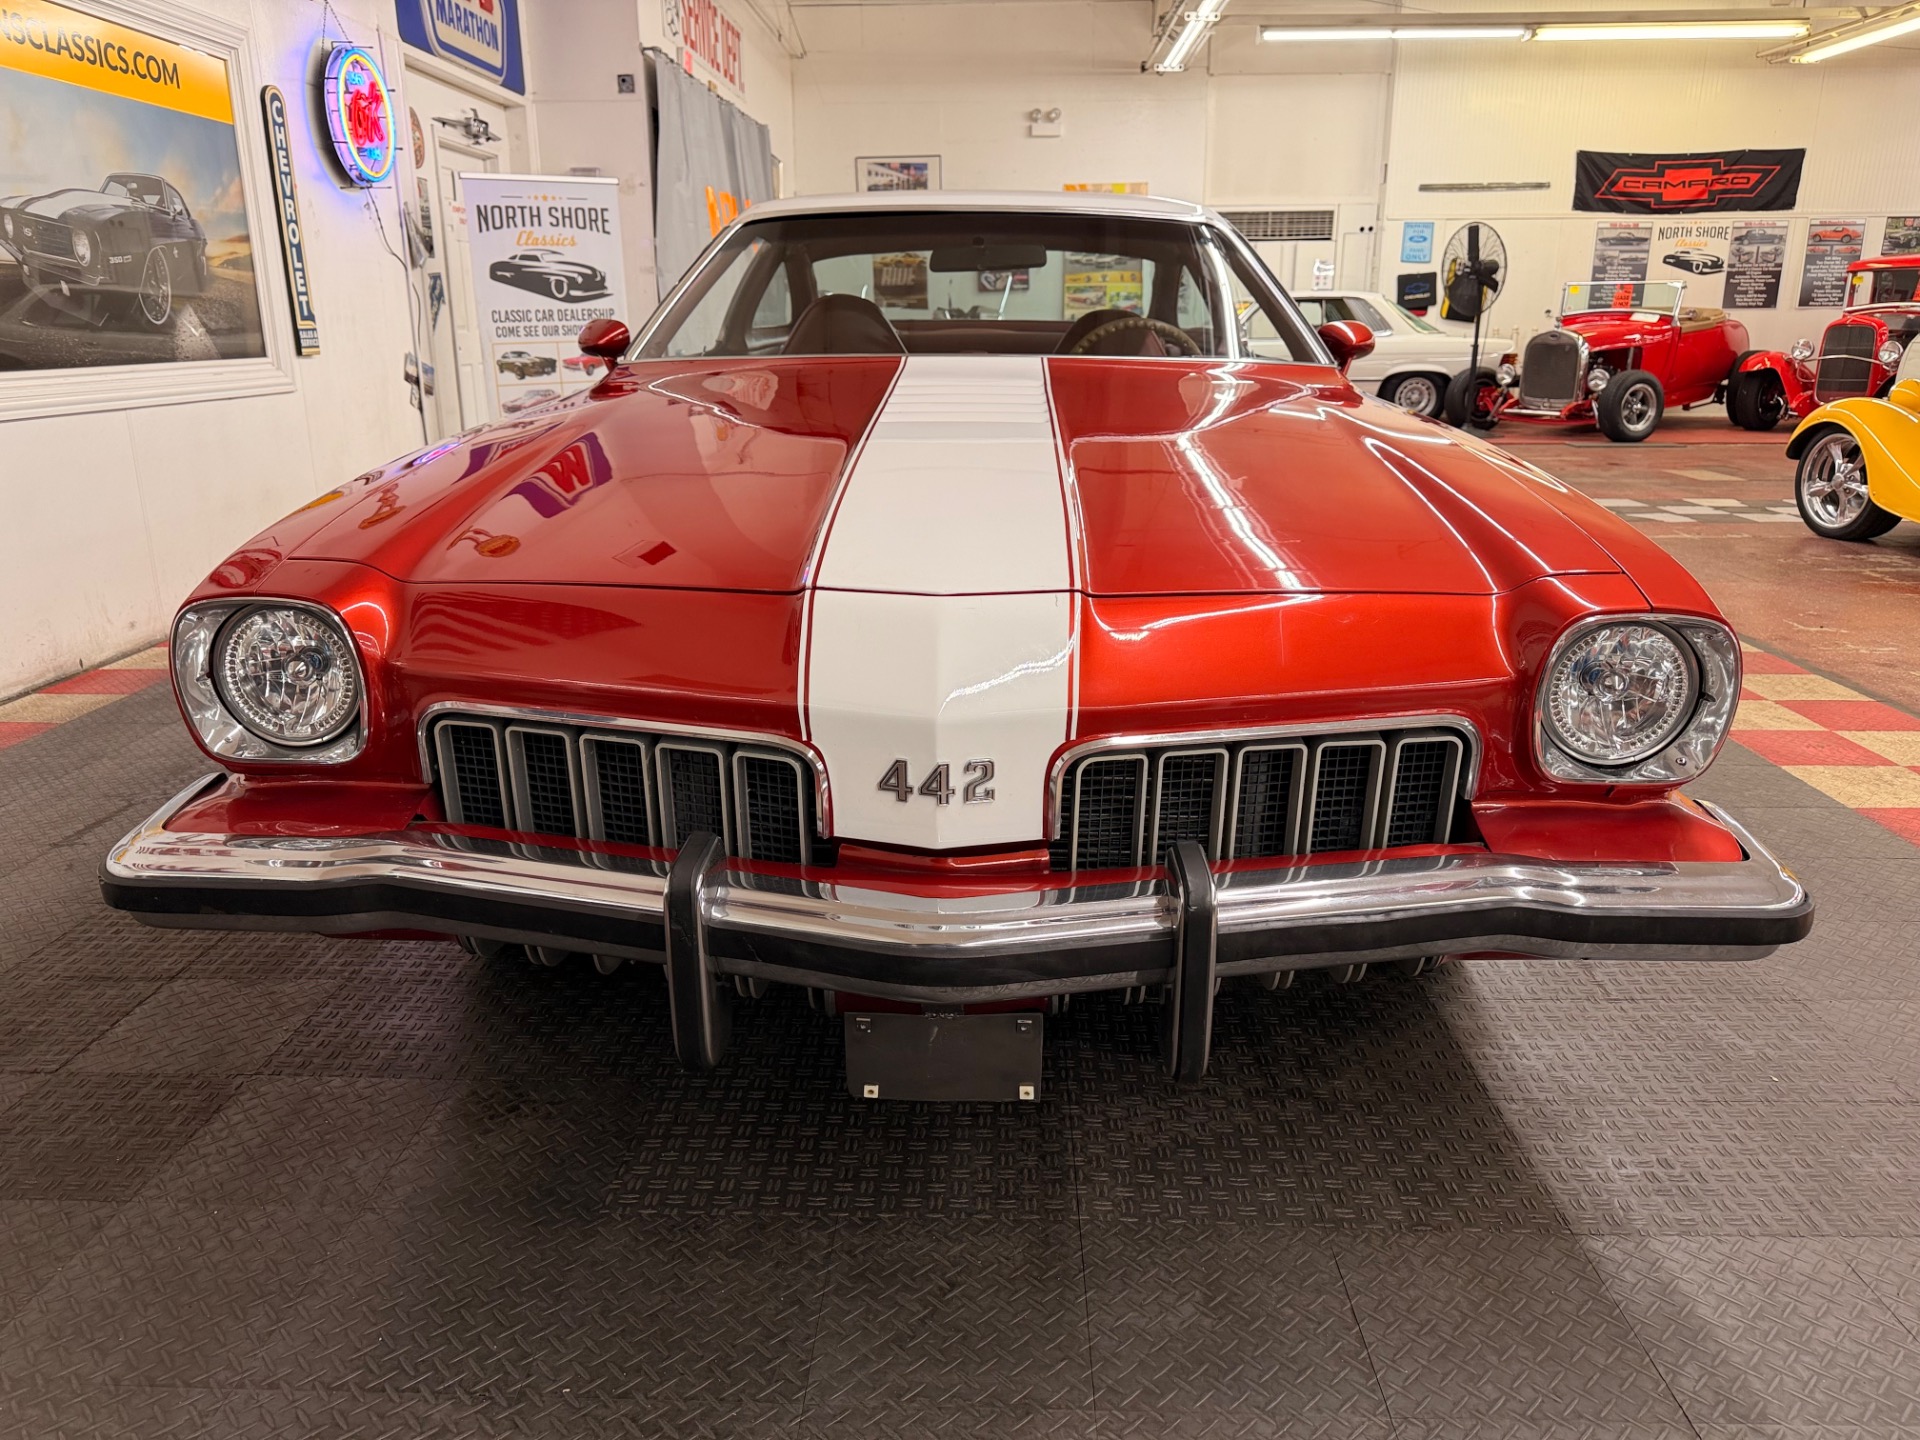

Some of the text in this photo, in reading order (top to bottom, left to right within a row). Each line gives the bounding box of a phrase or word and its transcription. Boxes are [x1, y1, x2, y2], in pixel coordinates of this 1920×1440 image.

[436, 0, 499, 51] MARATHON
[1622, 176, 1751, 190] CAMARO
[271, 100, 310, 317] CHEVROLET
[476, 204, 611, 235] NORTH SHORE
[515, 230, 578, 247] Classics
[1657, 226, 1730, 241] NORTH SHORE
[491, 308, 615, 324] CLASSIC CAR DEALERSHIP
[495, 325, 521, 339] COME
[523, 325, 539, 337] SEE
[542, 324, 560, 337] OUR
[877, 757, 995, 807] 442
